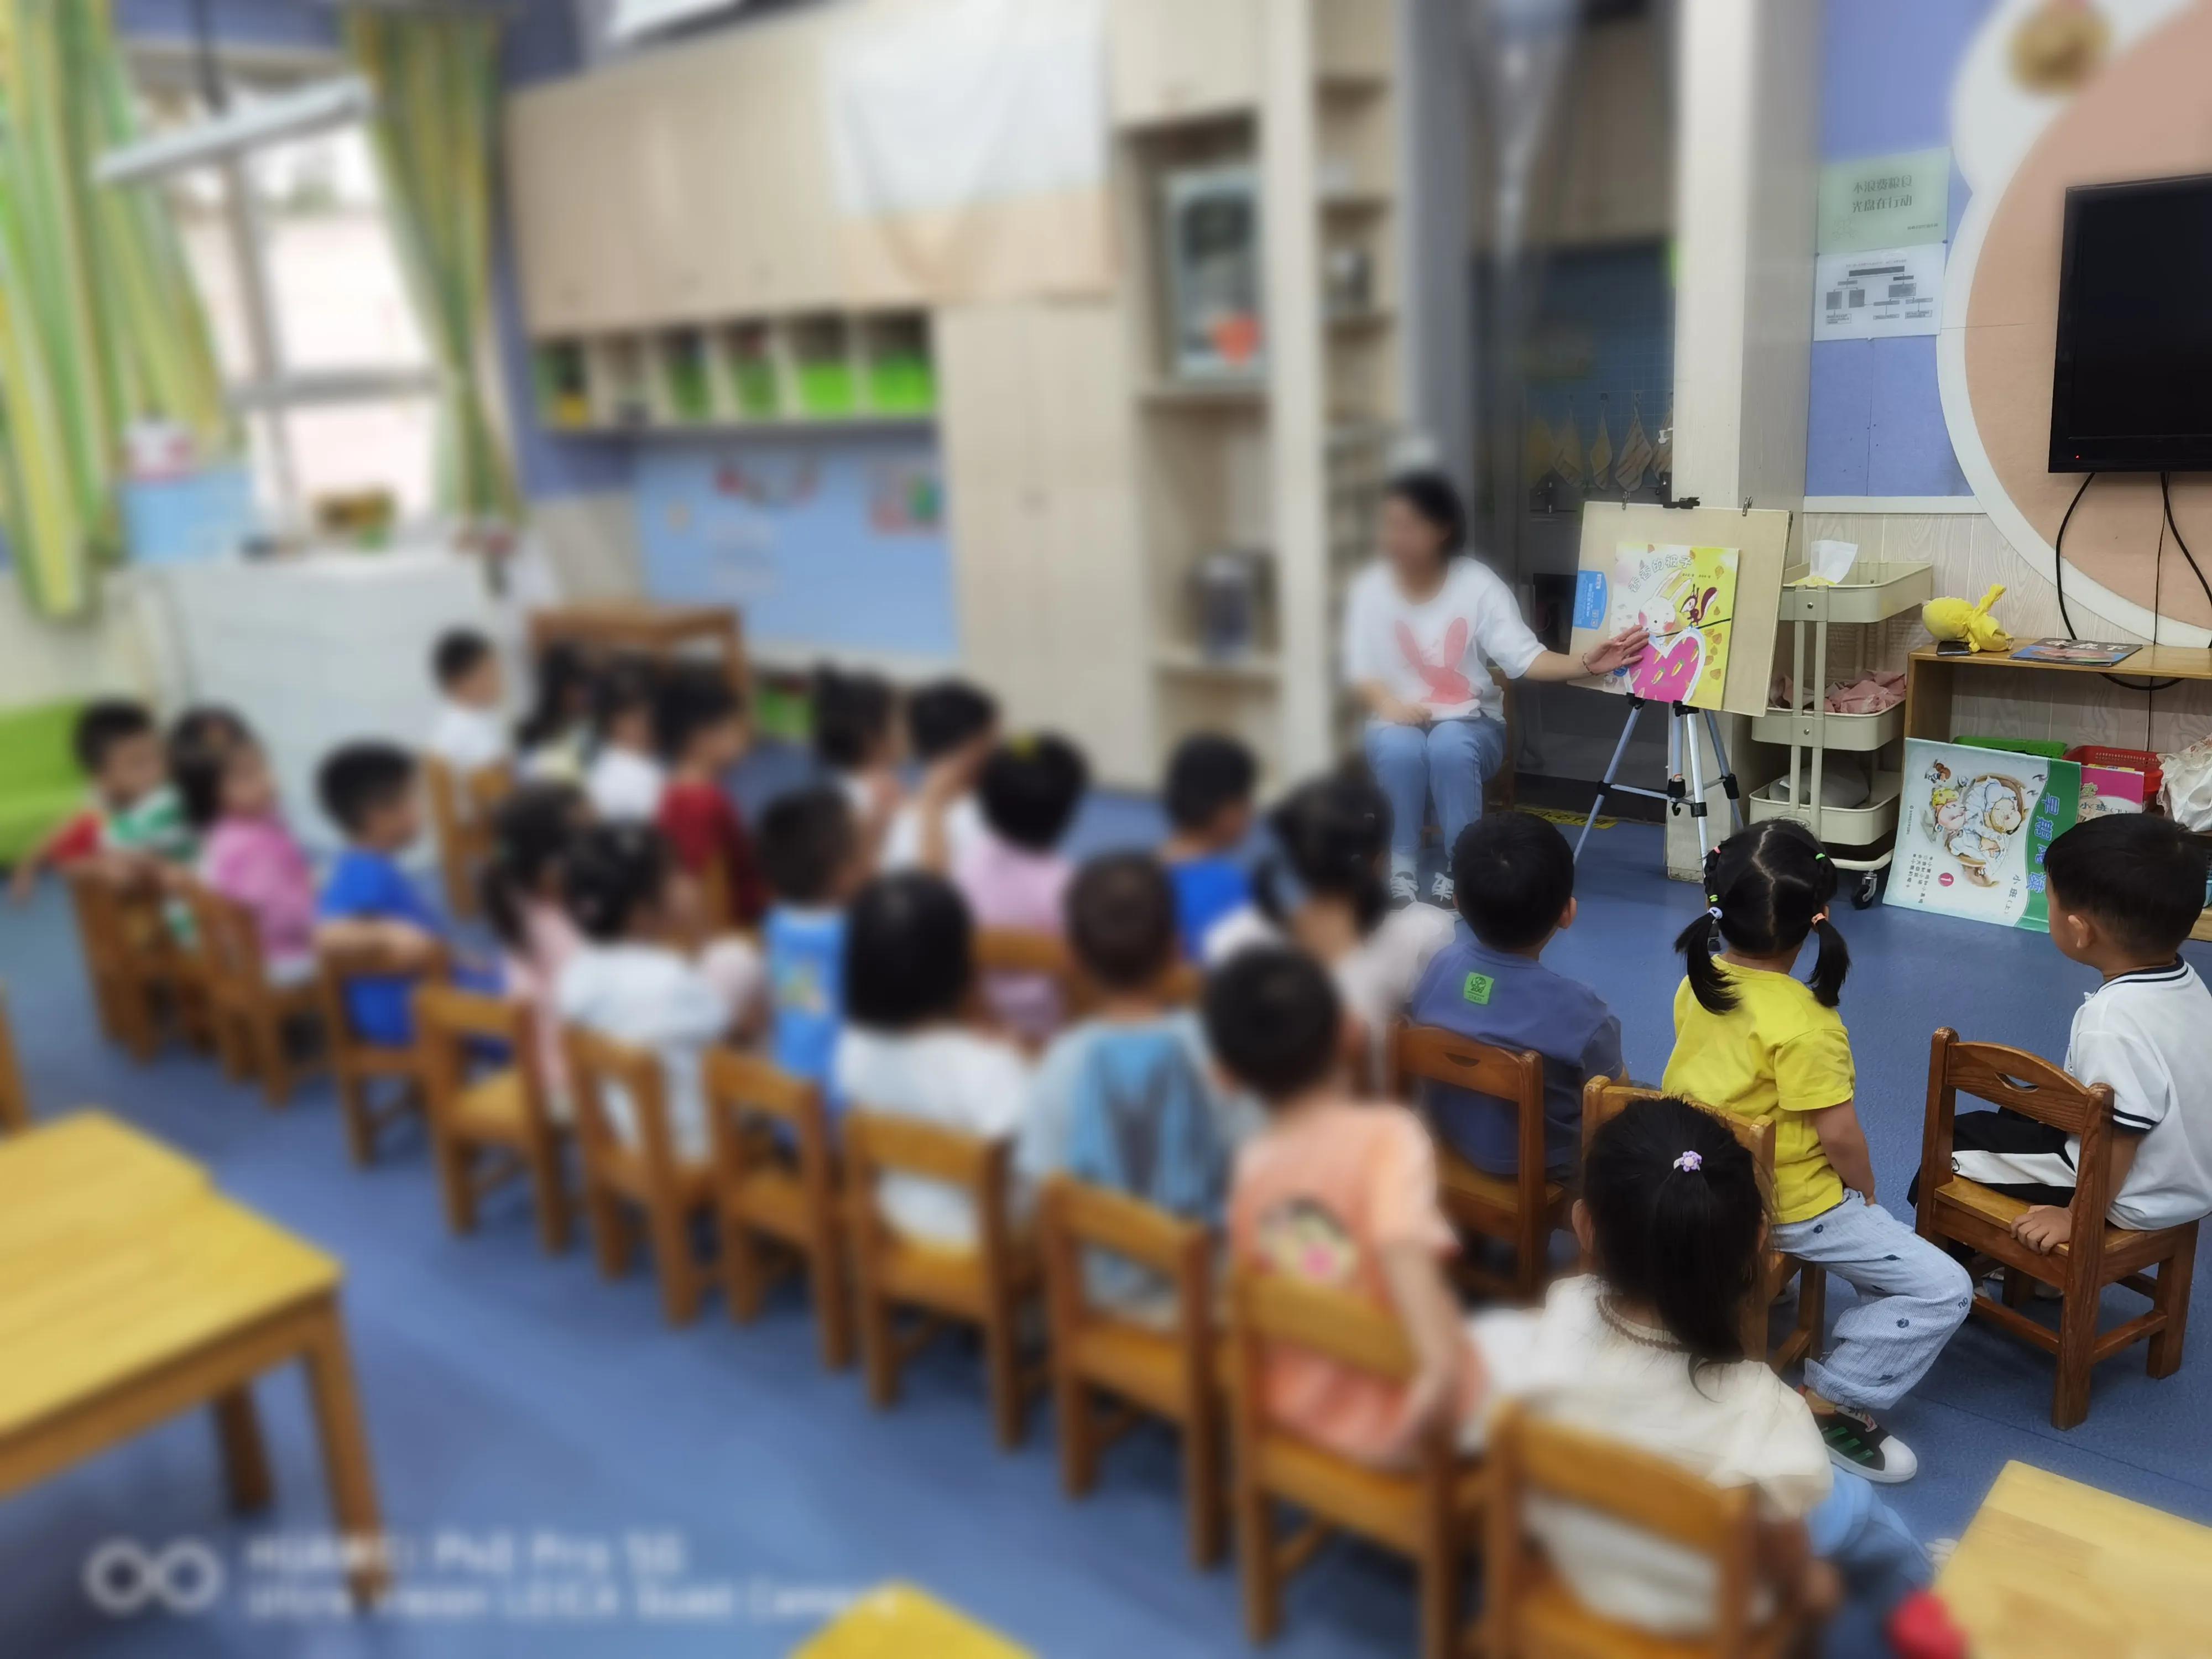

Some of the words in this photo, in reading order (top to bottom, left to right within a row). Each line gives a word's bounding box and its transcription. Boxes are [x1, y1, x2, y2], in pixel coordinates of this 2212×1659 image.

[1853, 175, 1912, 194] 不浪费粮食
[1852, 194, 1912, 213] 光盘在行动
[1628, 554, 1693, 593] 香香的被子
